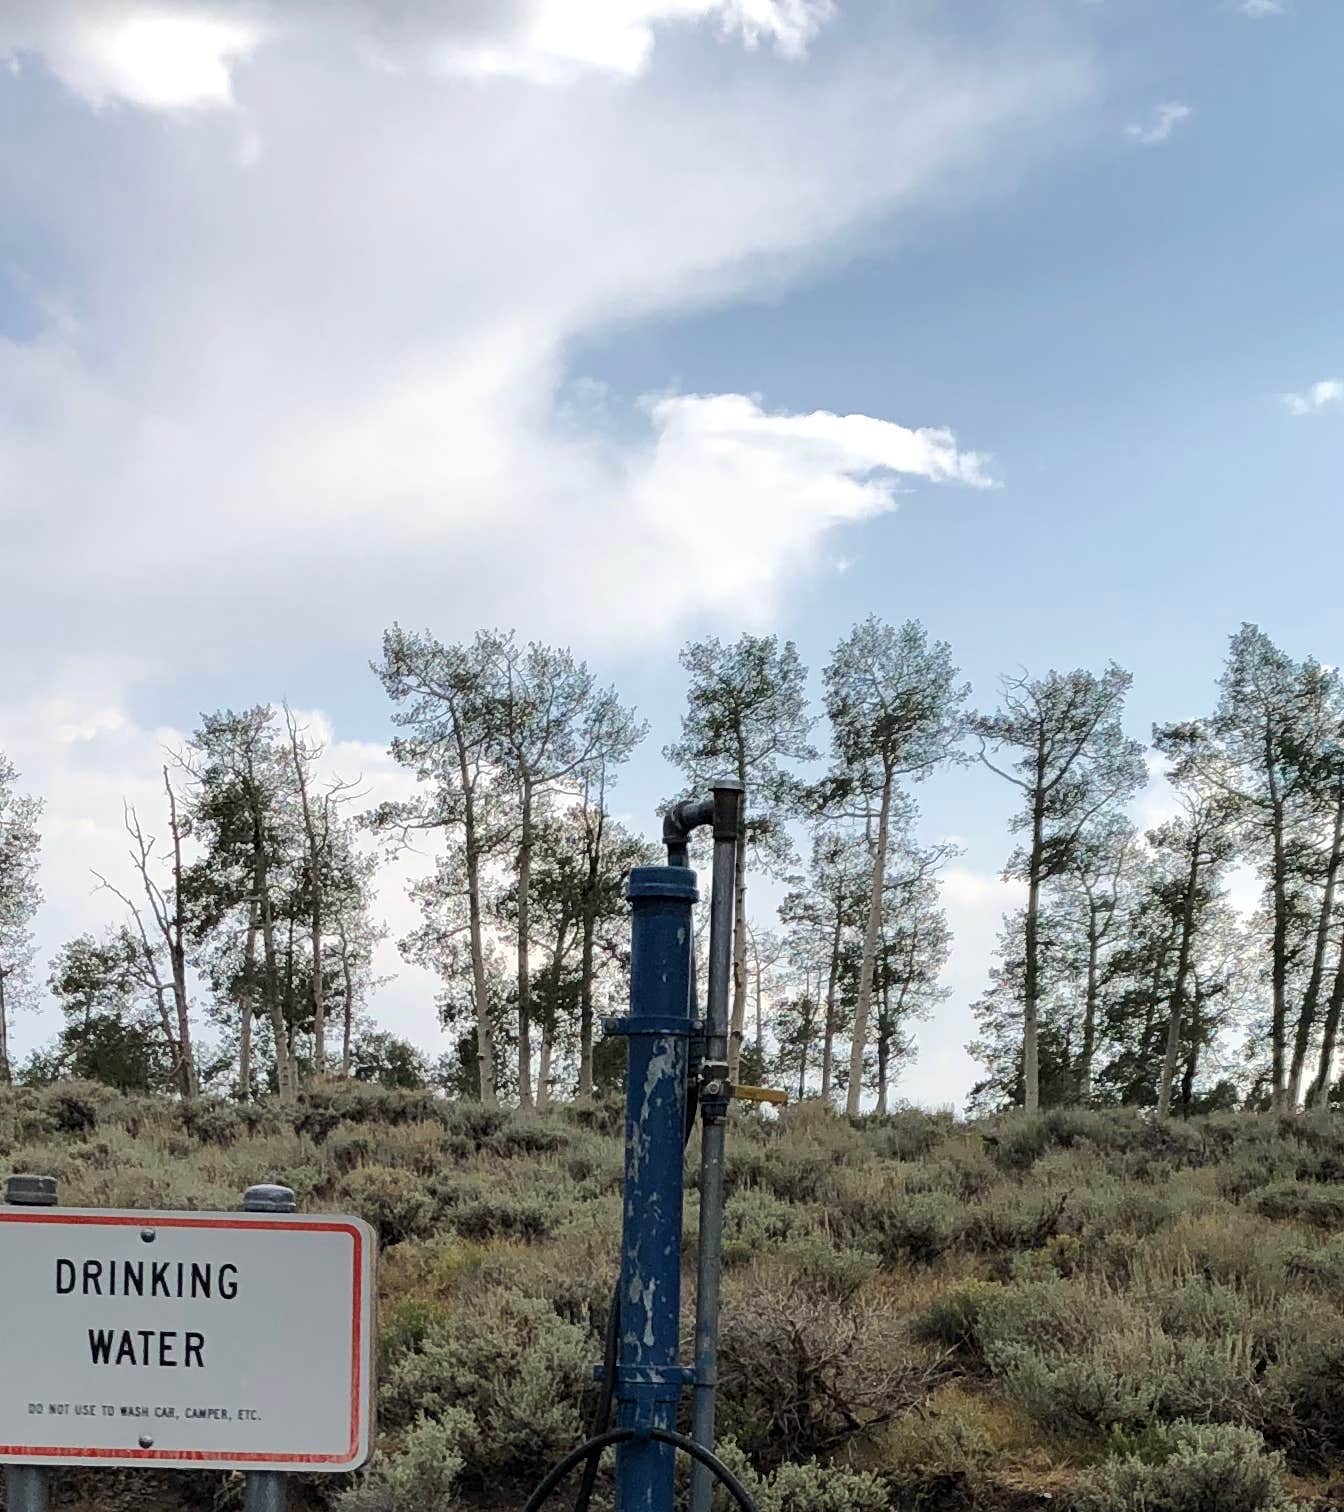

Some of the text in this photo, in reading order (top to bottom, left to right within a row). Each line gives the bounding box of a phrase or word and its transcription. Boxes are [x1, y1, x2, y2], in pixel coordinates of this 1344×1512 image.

[55, 1258, 239, 1300] DRINKING
[87, 1328, 205, 1368] WATER
[27, 1402, 263, 1422] DO NOT USE TO WASH CAR, CAMPER, ETC.
